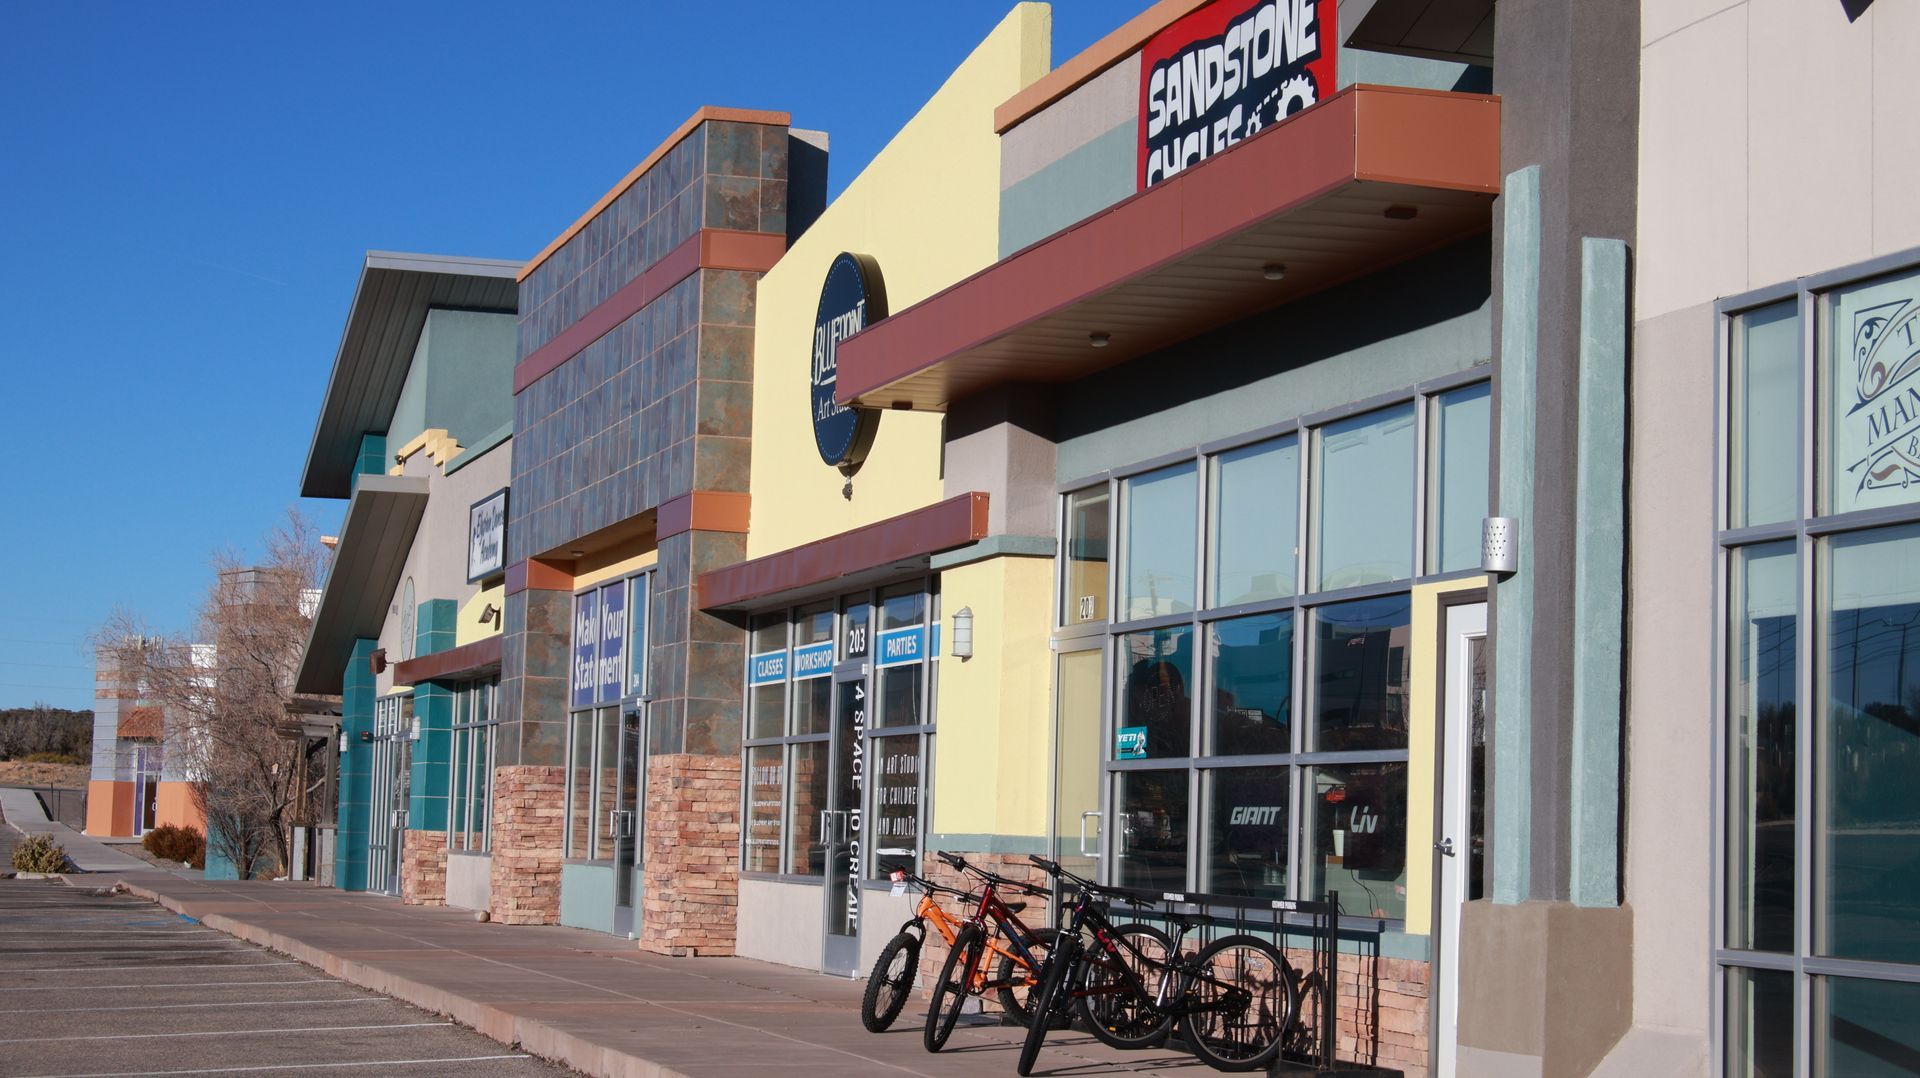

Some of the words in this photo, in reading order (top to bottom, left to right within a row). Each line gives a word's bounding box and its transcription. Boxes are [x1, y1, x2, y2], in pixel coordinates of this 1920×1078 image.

[1148, 0, 1317, 139] SANDSTONE
[817, 395, 831, 421] Art
[602, 603, 624, 641] Your
[849, 628, 865, 653] 203
[887, 635, 917, 657] PARTIES
[758, 658, 783, 677] CLASSES
[1118, 733, 1136, 742] YETI
[887, 754, 898, 774] ART
[878, 817, 889, 835] AND
[893, 815, 916, 836] ADULTS
[1230, 806, 1281, 825] GIANT
[1350, 805, 1378, 833] Liv
